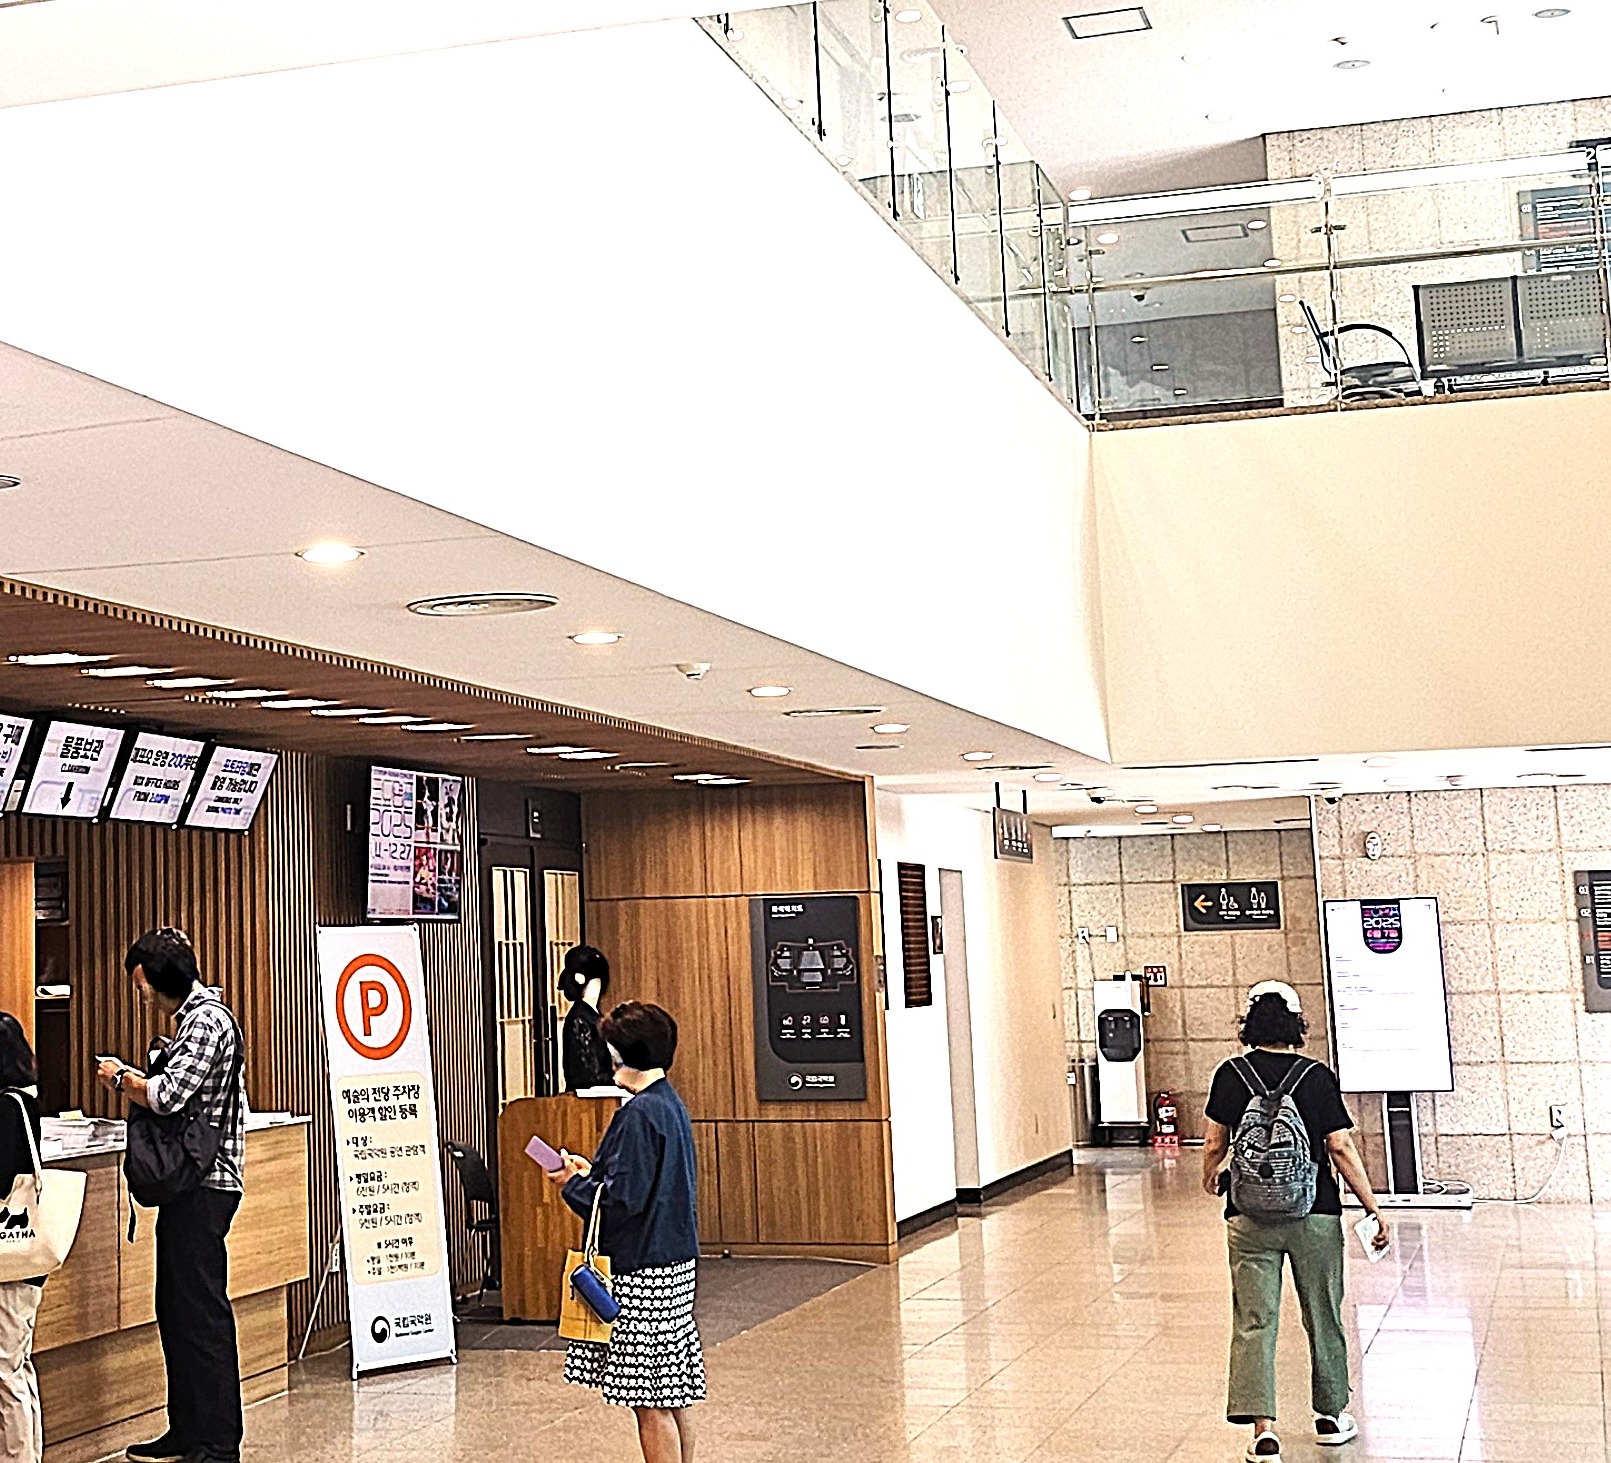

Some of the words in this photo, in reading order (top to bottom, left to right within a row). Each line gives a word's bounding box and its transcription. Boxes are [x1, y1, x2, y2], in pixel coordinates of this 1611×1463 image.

[59, 735, 105, 761] 물품보관
[1363, 917, 1400, 928] 2025
[359, 980, 389, 1036] P
[341, 1086, 369, 1103] 예술의
[371, 1085, 391, 1102] 전당
[392, 1083, 421, 1101] 주차장
[347, 1105, 377, 1123] 이용객
[394, 1313, 432, 1328] 국립국악원
